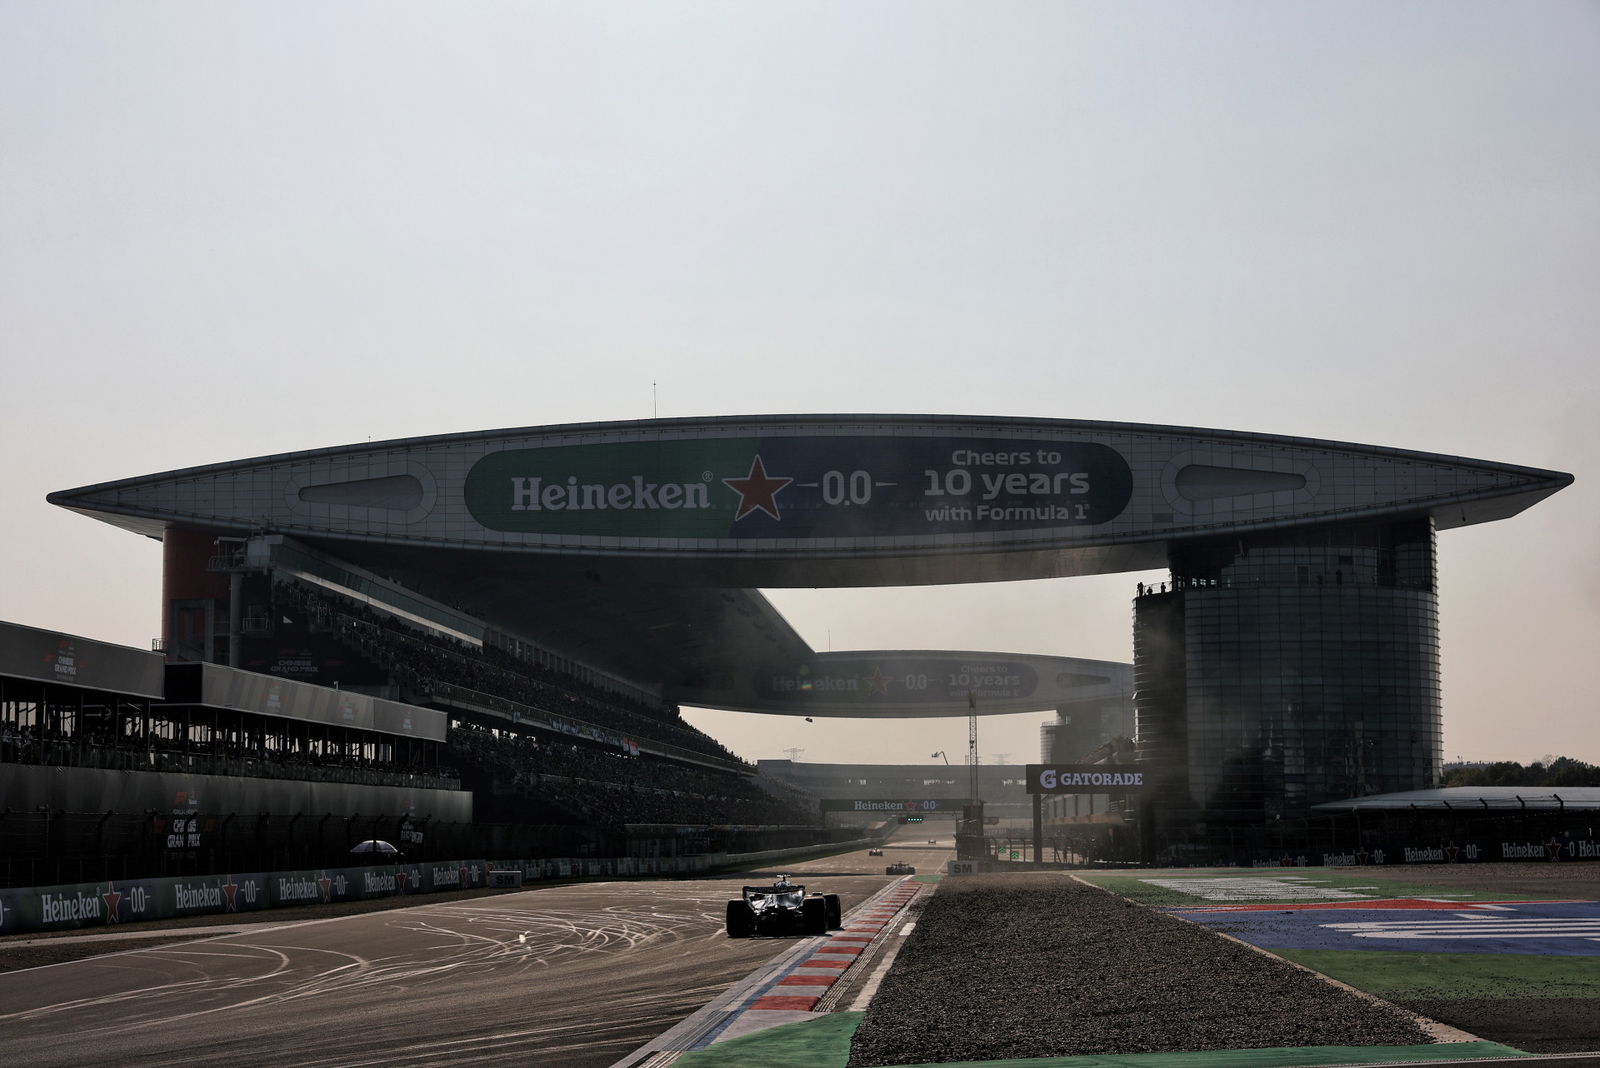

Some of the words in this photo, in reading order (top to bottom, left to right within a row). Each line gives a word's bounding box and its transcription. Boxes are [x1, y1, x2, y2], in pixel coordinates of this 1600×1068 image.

[951, 450, 1031, 465] Cheers
[1036, 450, 1062, 465] to
[924, 469, 972, 496] 10
[980, 472, 1090, 500] years
[925, 505, 972, 521] with
[976, 504, 1069, 520] Formula
[949, 674, 969, 686] 10
[974, 675, 1020, 688] years
[1060, 773, 1143, 785] GATORADE
[854, 801, 903, 810] Heineken
[1404, 847, 1444, 862] Heineken
[1502, 842, 1545, 858] Heineken
[953, 863, 972, 874] SM
[496, 874, 515, 885] SM
[174, 882, 221, 909] Heineken
[279, 876, 318, 900] Heineken
[41, 891, 100, 923] Heineken
